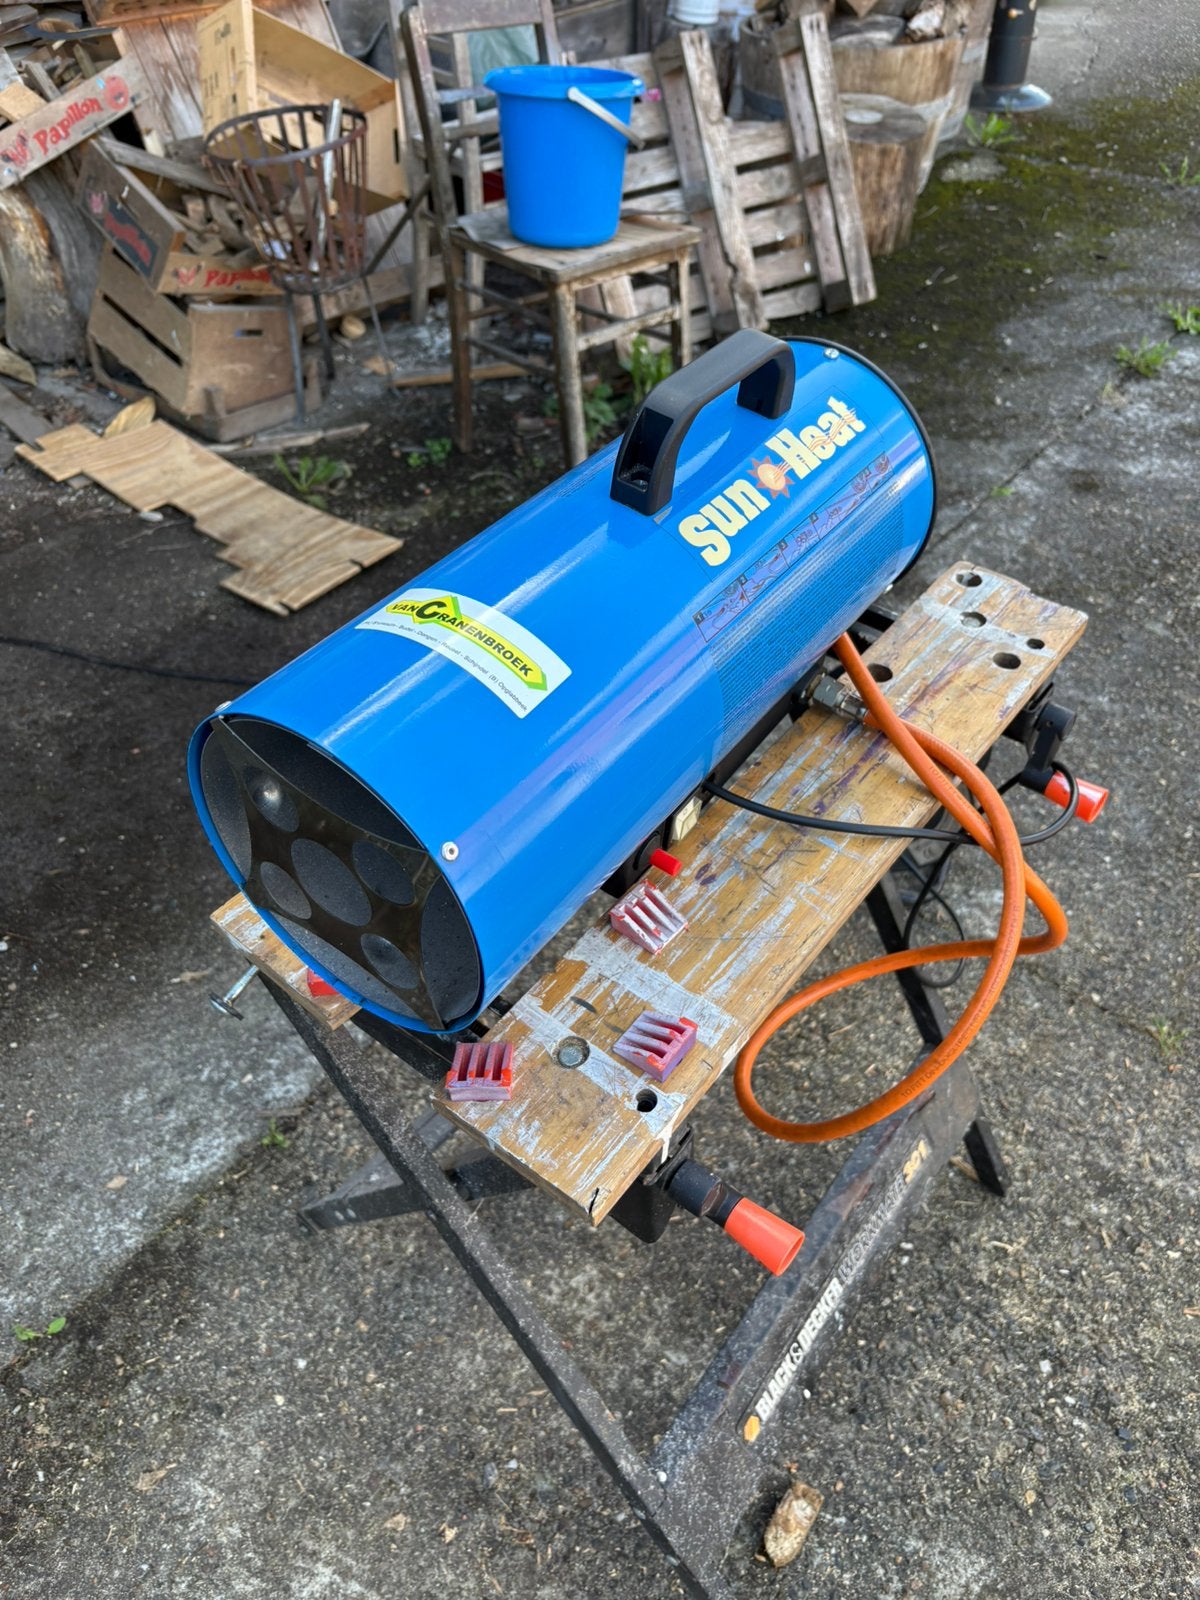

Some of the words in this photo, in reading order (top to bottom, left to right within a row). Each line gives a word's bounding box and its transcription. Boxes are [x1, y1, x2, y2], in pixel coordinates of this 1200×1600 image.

[33, 97, 104, 156] Papillon
[678, 479, 771, 566] Sun
[764, 396, 866, 480] Heat
[393, 603, 419, 613] VAN
[416, 601, 533, 677] CRANENBROEK
